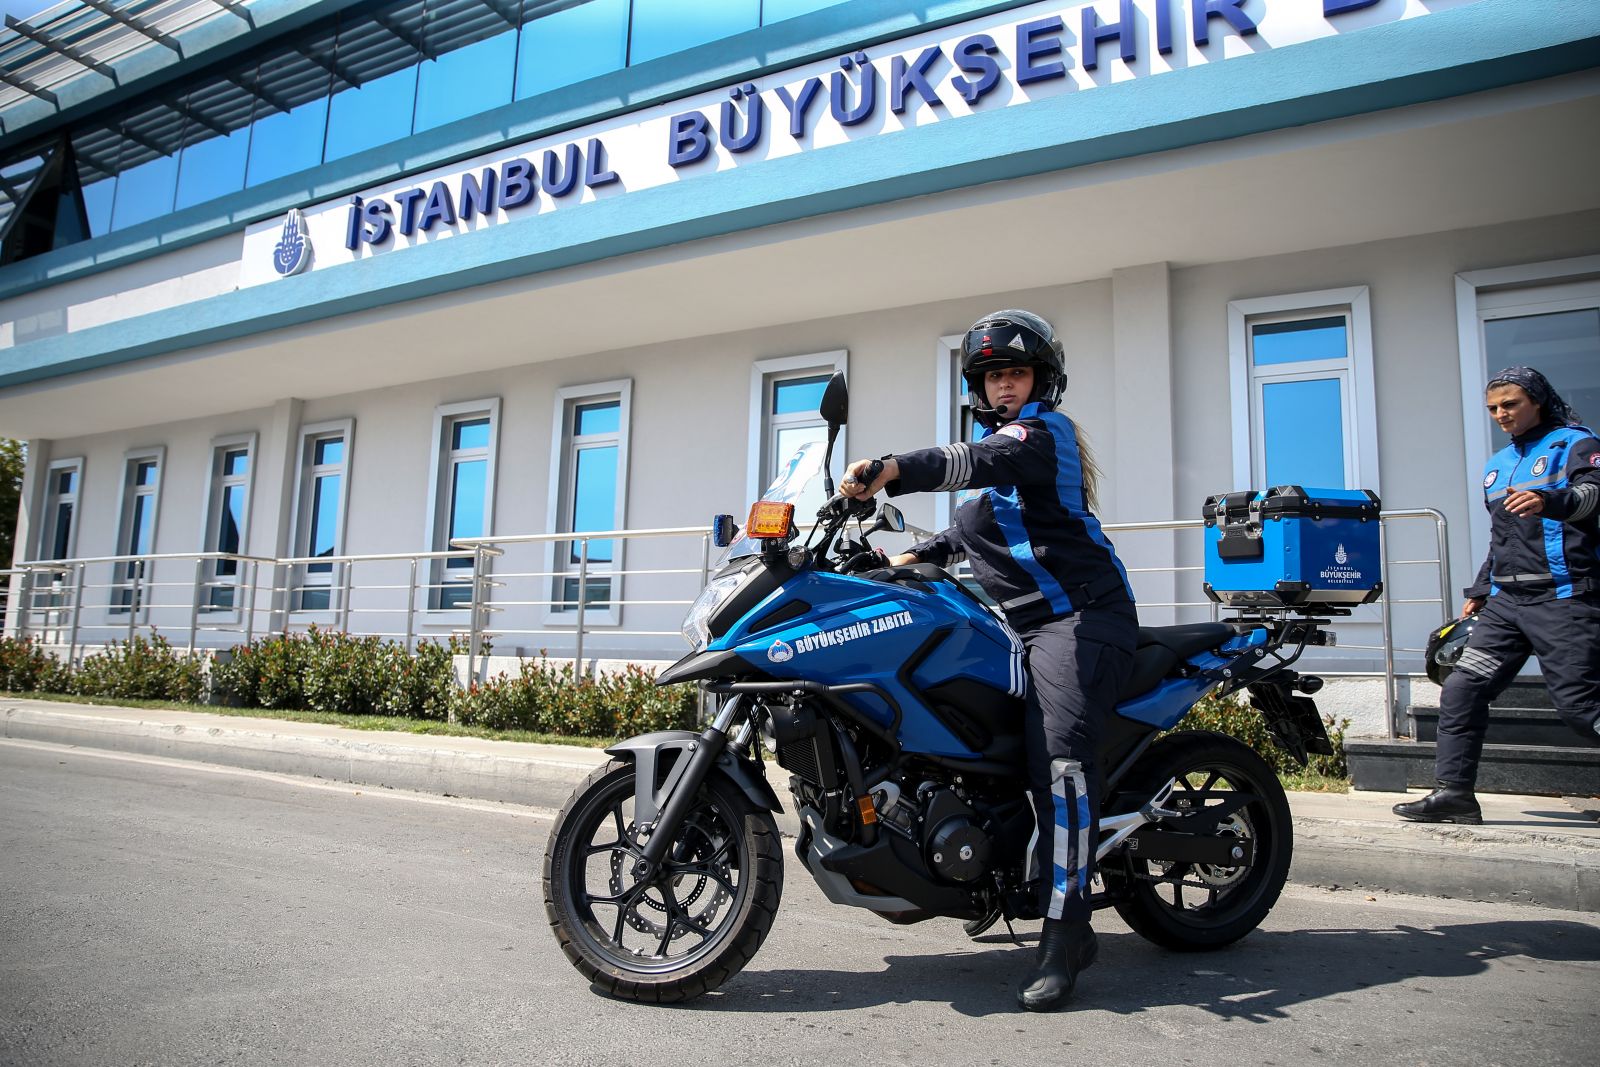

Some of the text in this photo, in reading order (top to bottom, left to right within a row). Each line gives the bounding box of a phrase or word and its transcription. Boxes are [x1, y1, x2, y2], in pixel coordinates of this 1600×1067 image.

[345, 138, 619, 251] İSTANBUL
[1320, 569, 1362, 580] BÜYÜKŞEHİR
[795, 621, 871, 655] BÜYÜKŞEHİR
[871, 611, 913, 634] ZABITA
